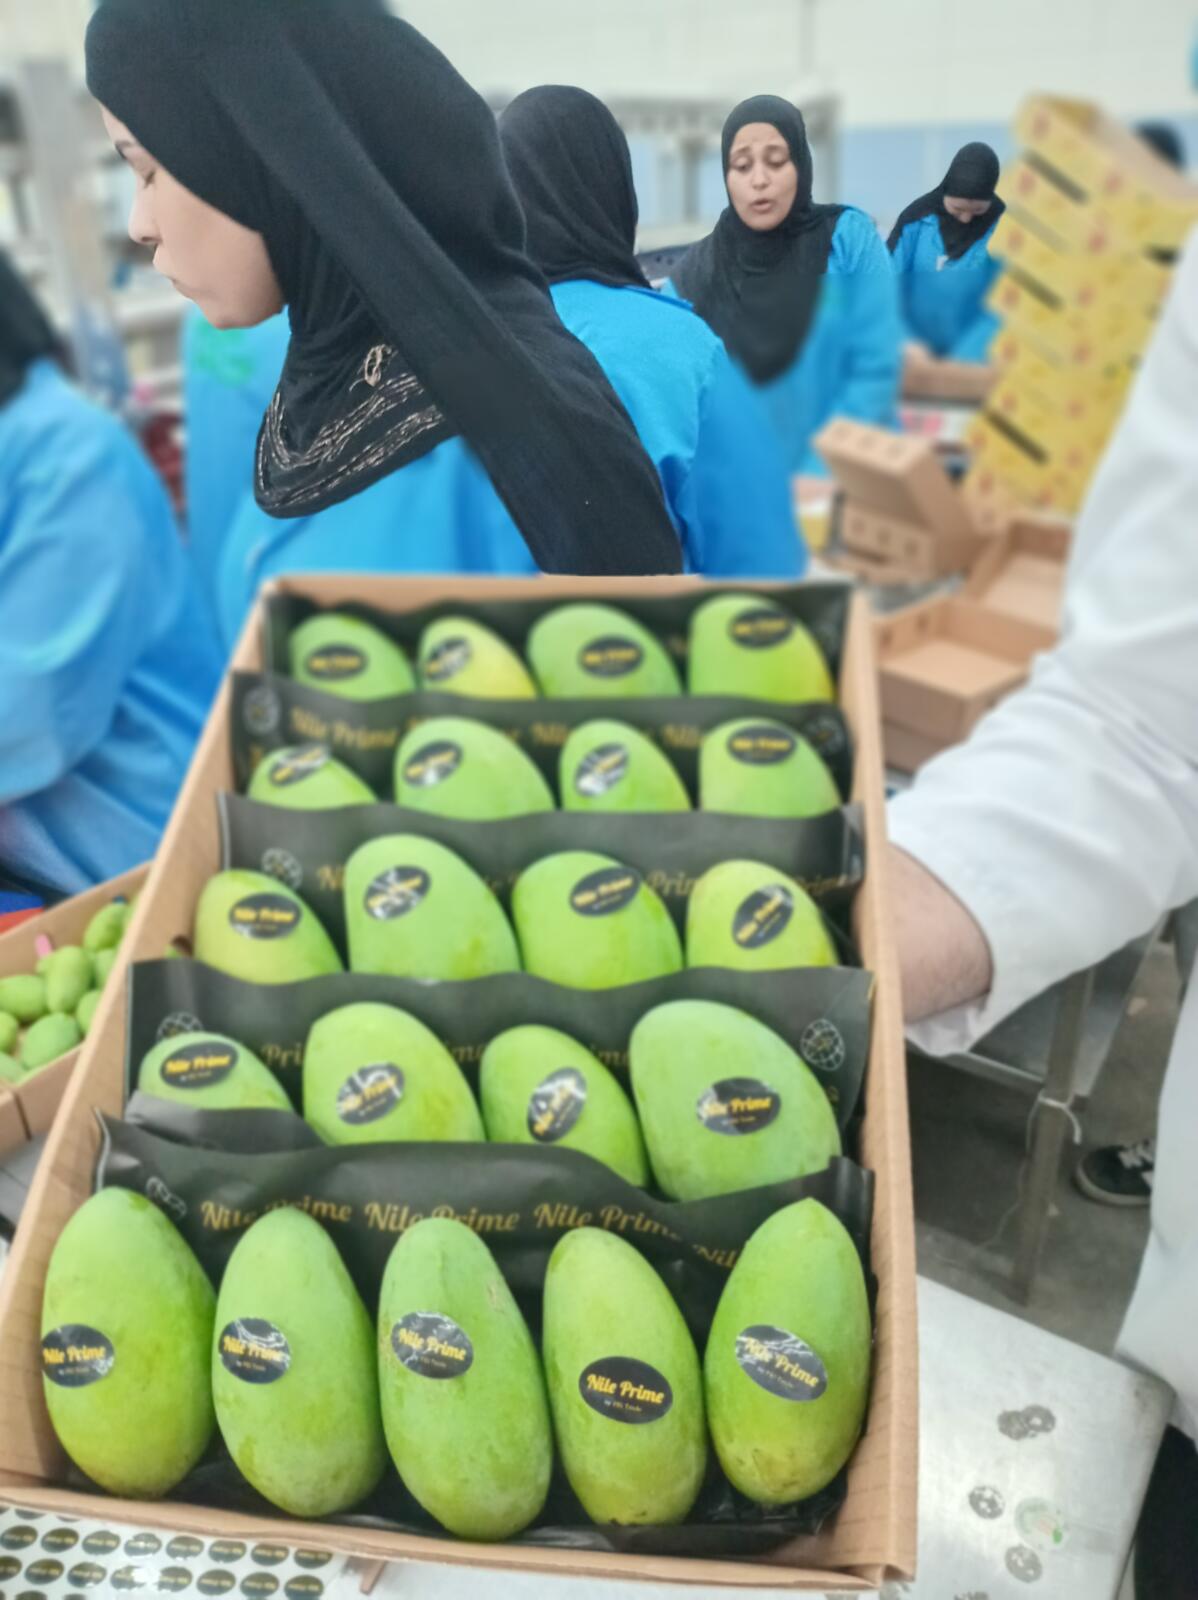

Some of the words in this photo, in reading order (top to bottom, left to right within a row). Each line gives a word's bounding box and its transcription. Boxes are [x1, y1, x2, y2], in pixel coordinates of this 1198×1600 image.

[261, 1044, 304, 1067] Pri
[534, 1202, 592, 1229] Nile
[691, 1242, 738, 1269] Nil
[66, 1344, 106, 1362] Prime
[398, 1327, 424, 1350] Nile
[426, 1335, 467, 1361] Prime
[775, 1353, 819, 1387] Prime
[587, 1374, 617, 1394] Nile
[619, 1380, 665, 1405] Prime
